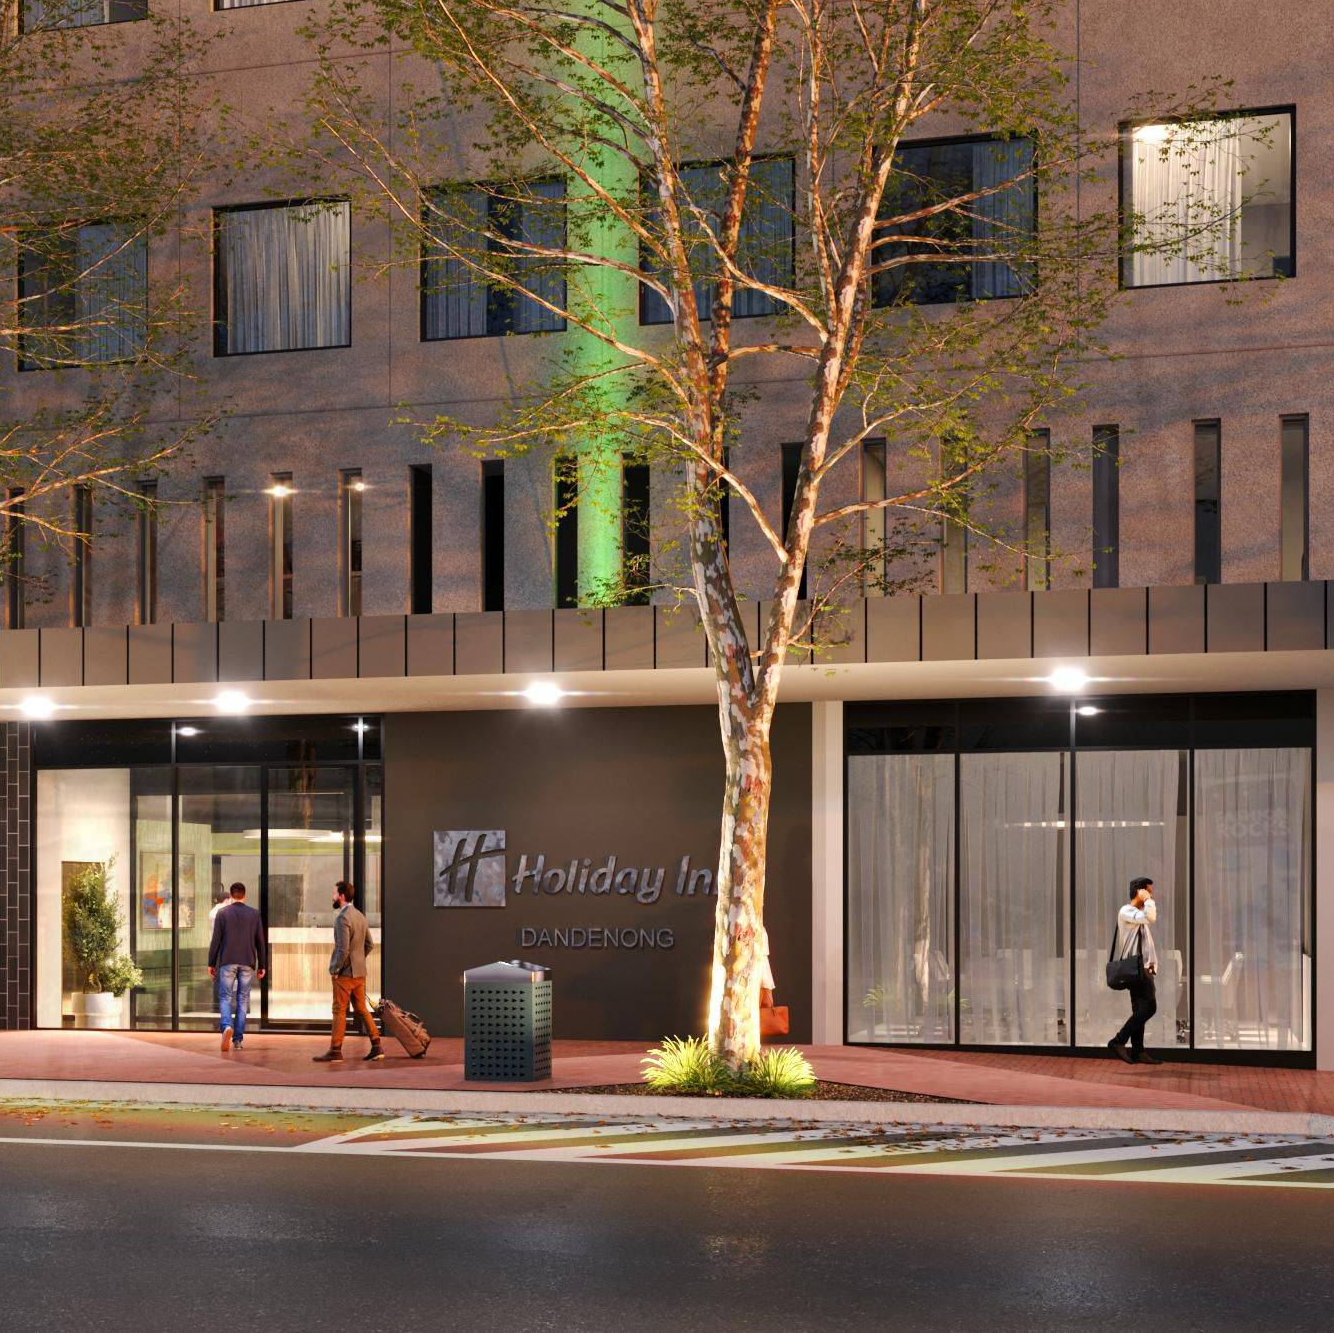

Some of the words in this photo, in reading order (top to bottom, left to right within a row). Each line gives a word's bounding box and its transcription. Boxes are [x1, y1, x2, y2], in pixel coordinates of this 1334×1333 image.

[512, 854, 666, 904] Holiday
[675, 854, 719, 896] In
[521, 927, 675, 948] DANDENONG
